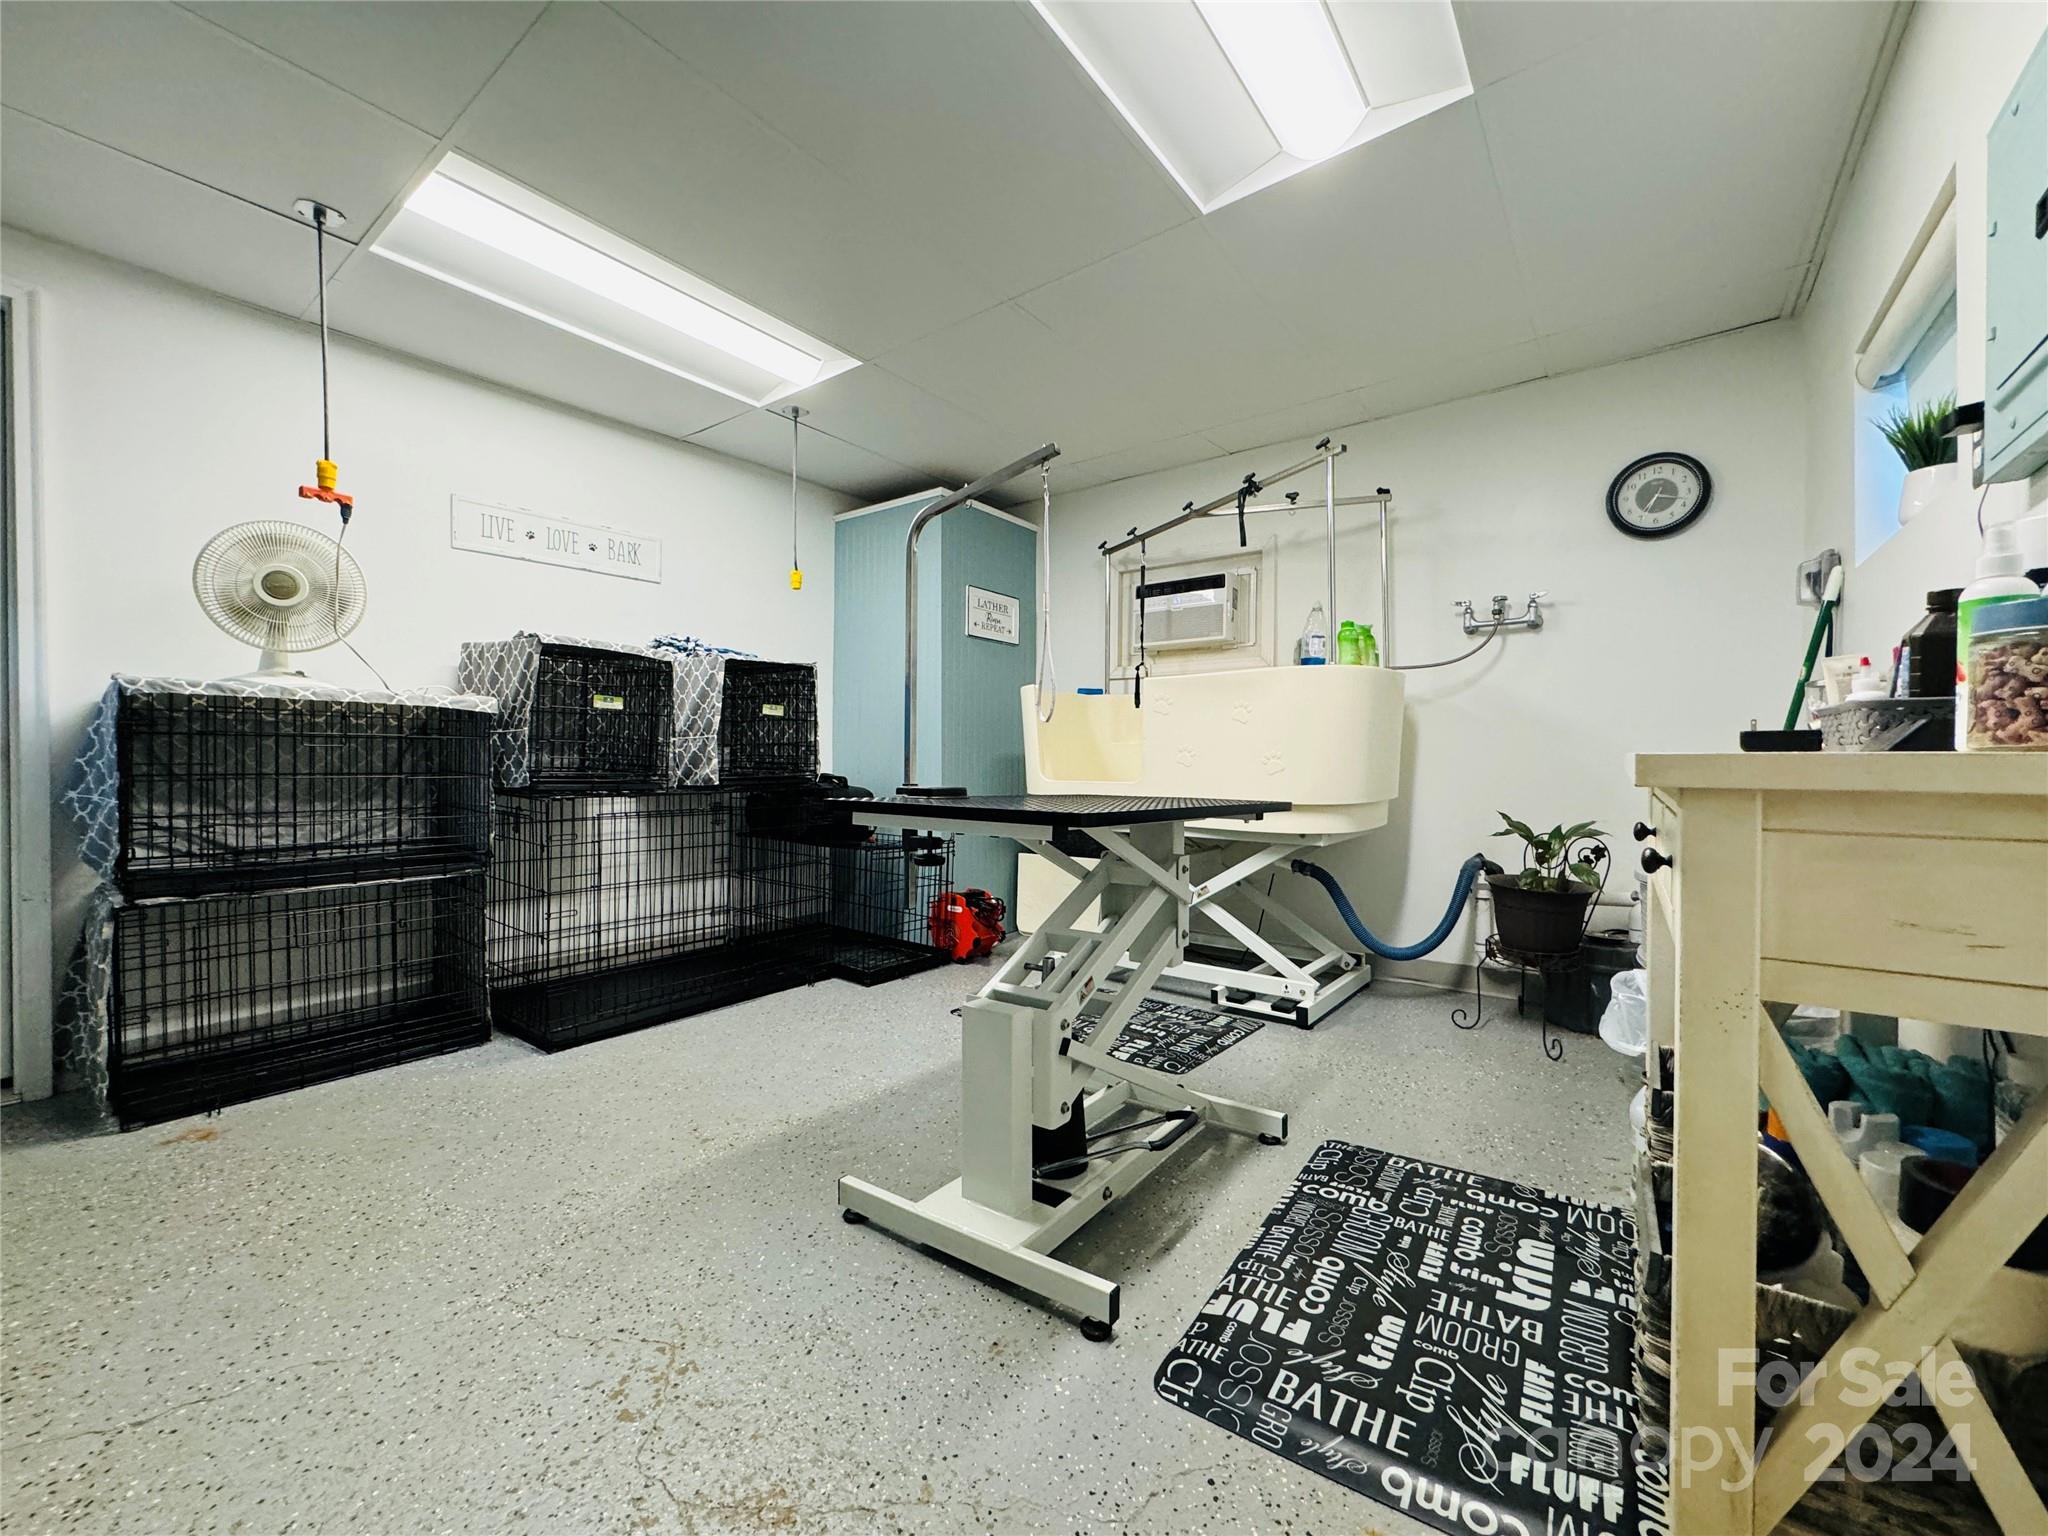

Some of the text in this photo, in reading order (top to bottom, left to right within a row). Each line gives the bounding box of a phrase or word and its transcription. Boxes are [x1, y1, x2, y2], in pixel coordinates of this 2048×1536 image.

[481, 513, 642, 566] LIVE LOVE BARK
[977, 598, 1009, 614] LATHER
[981, 621, 1005, 634] REPEAT
[1307, 1149, 1343, 1170] Clip
[1387, 1156, 1486, 1188] BATHE
[1302, 1184, 1389, 1212] comb
[1398, 1187, 1444, 1217] Clip
[1465, 1188, 1559, 1218] comb
[1252, 1225, 1296, 1262] BATHE
[1291, 1208, 1343, 1264] Scissor
[1329, 1206, 1394, 1264] GROOM
[1393, 1216, 1452, 1242] BATHE
[1453, 1216, 1486, 1261] comb
[1484, 1208, 1519, 1257] Scissor
[1237, 1258, 1285, 1281] Clip
[1417, 1240, 1449, 1283] FLUFF
[1449, 1261, 1505, 1289] trim
[1494, 1238, 1556, 1312] trim
[1564, 1226, 1633, 1284] Style
[1298, 1256, 1346, 1315] comb
[1345, 1276, 1369, 1295] Clip
[1353, 1247, 1417, 1315] Style
[1219, 1321, 1238, 1344] comb
[1317, 1296, 1357, 1348] Scissor
[1415, 1311, 1521, 1368] GROOM
[1426, 1288, 1544, 1346] BATHE
[1558, 1298, 1610, 1374] GROOM
[1356, 1314, 1406, 1370] trim
[1412, 1339, 1460, 1360] comb
[1282, 1348, 1384, 1390] Style
[1395, 1356, 1456, 1414] Clip
[1519, 1358, 1556, 1428] FLUFF
[1250, 1401, 1293, 1449] GRO
[1267, 1368, 1418, 1458] BATHE
[1446, 1362, 1554, 1497] Style
[1297, 1435, 1372, 1475] Style
[1567, 1419, 1620, 1478] GROOM
[1510, 1452, 1625, 1523] FLUFF
